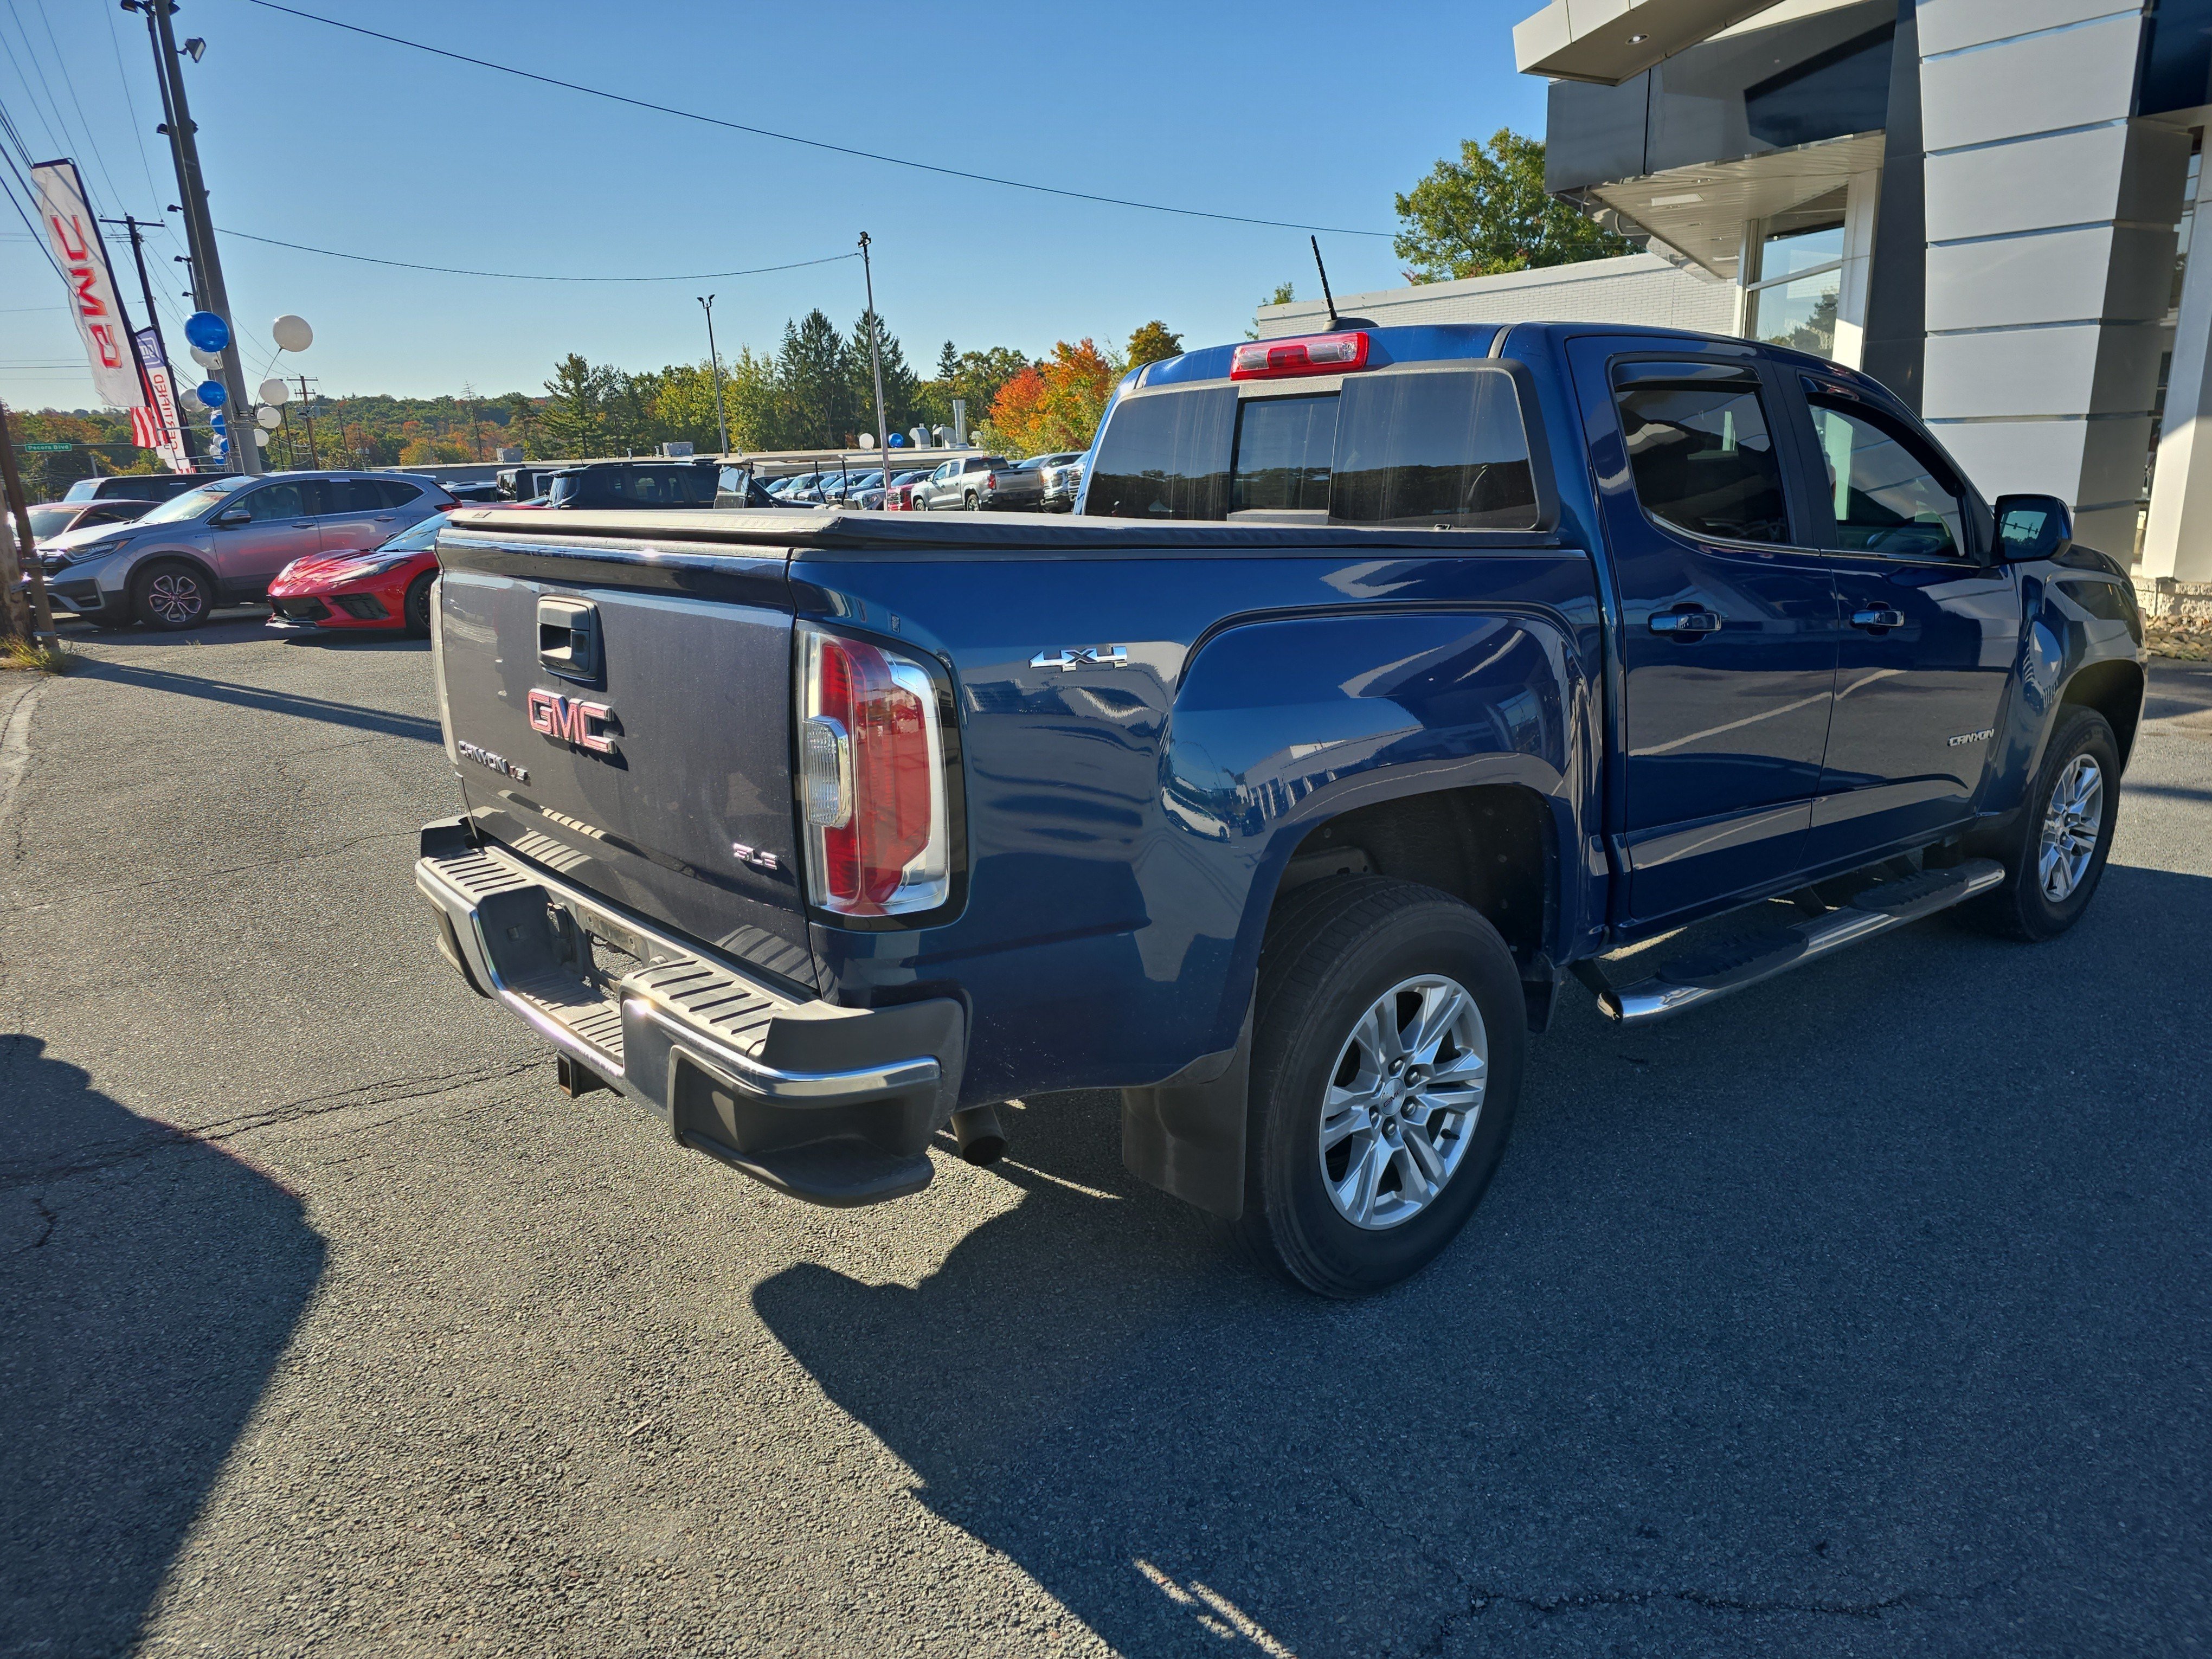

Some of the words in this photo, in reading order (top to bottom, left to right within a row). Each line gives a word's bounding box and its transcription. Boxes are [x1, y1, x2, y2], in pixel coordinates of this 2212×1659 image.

[528, 688, 617, 754] GMC
[1947, 729, 1995, 747] CANYON
[459, 741, 509, 774] CANYON
[733, 843, 777, 870] SLE
[1384, 1086, 1403, 1107] GMC
